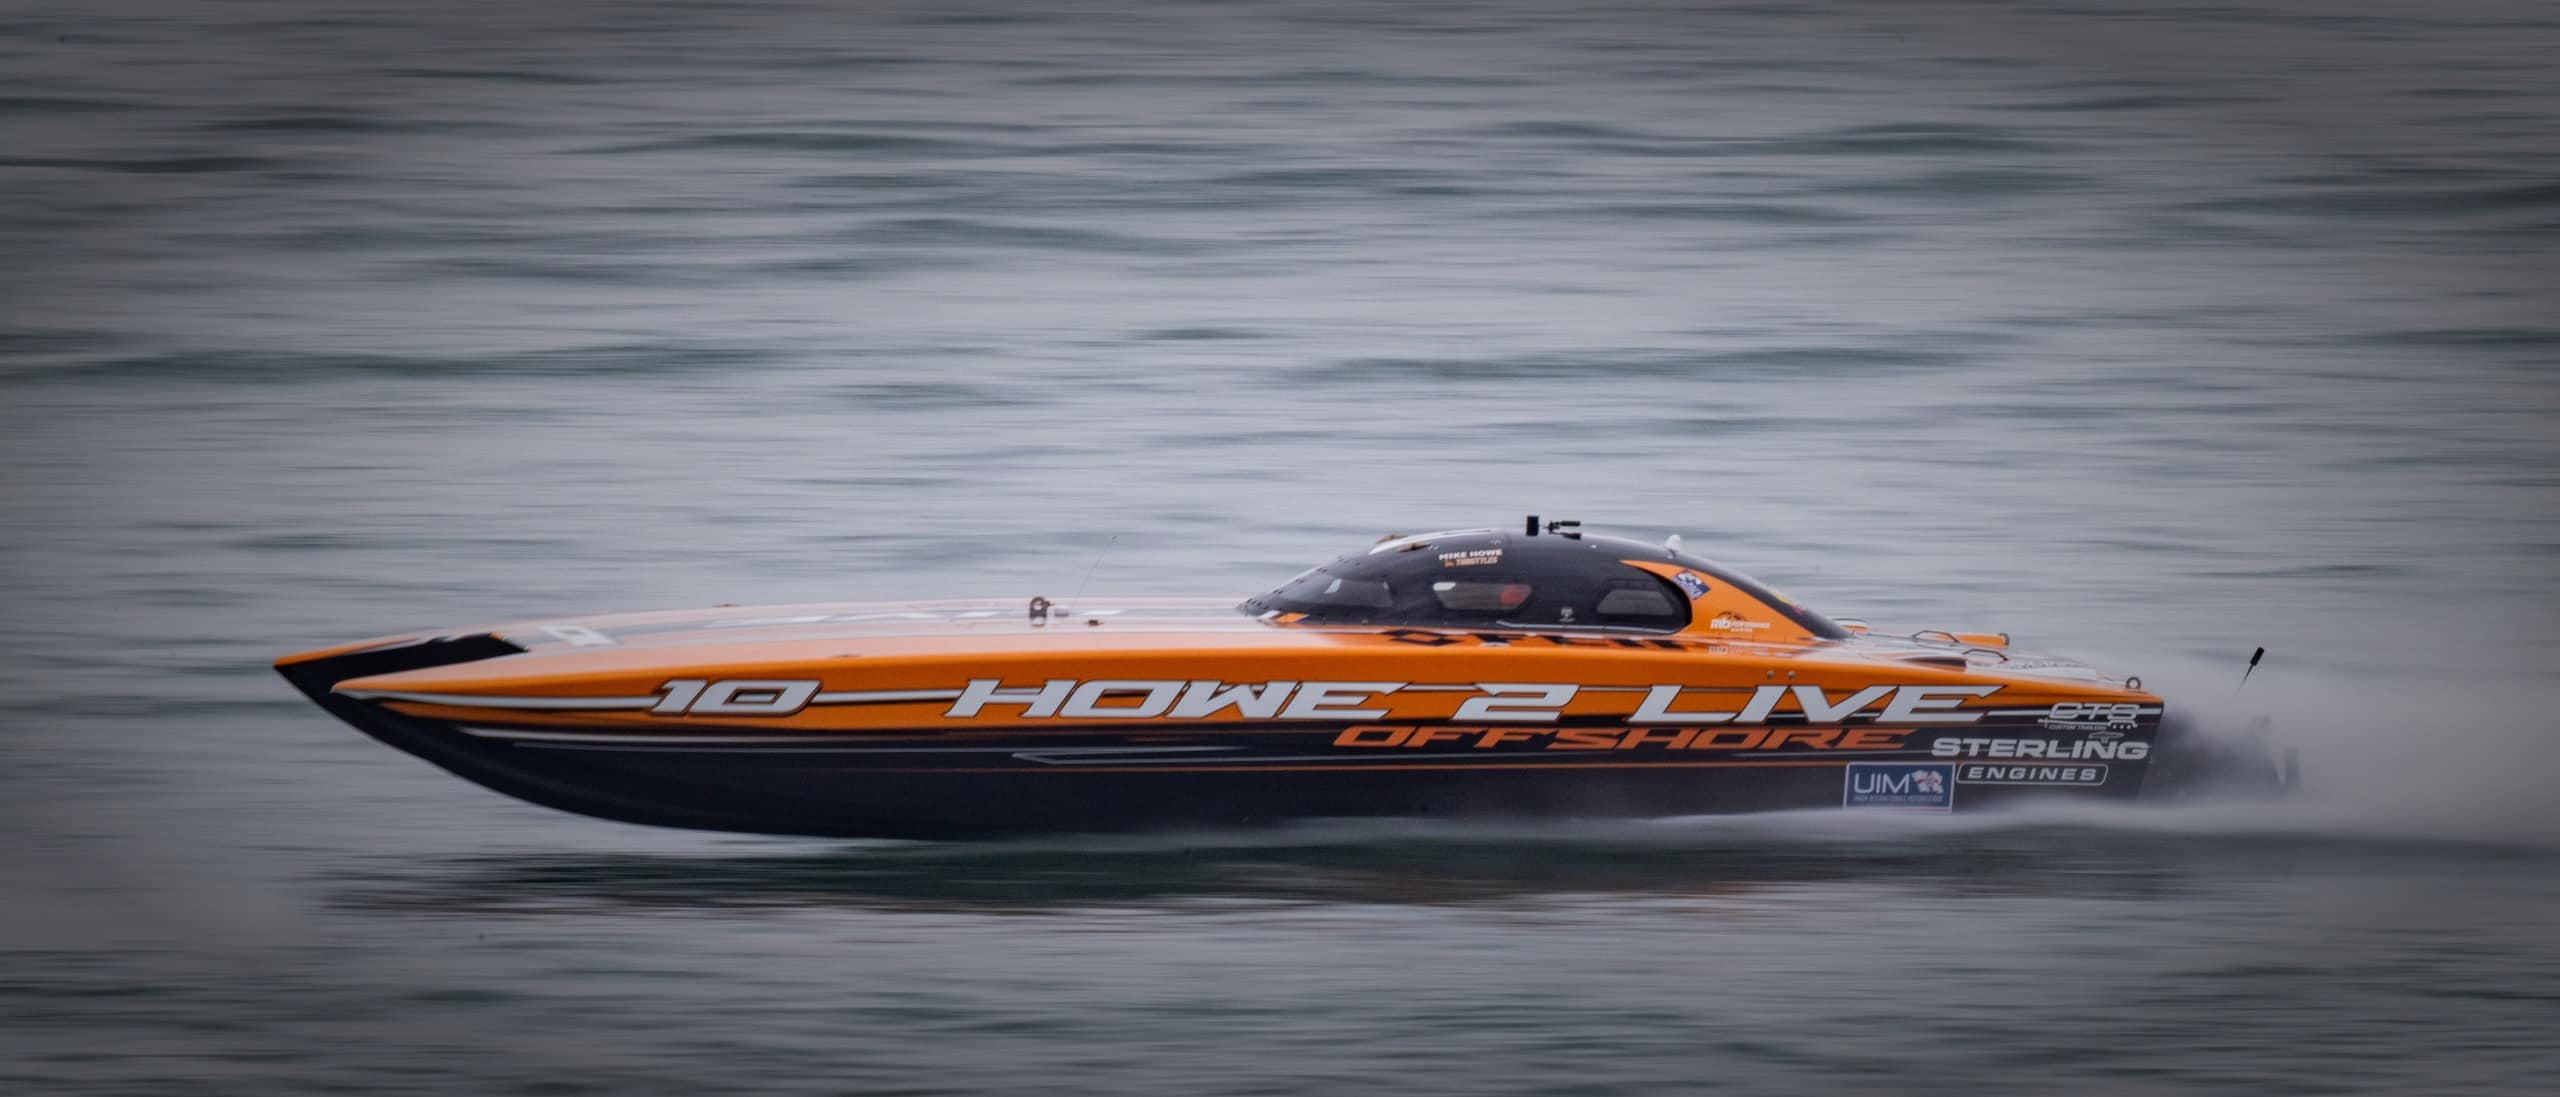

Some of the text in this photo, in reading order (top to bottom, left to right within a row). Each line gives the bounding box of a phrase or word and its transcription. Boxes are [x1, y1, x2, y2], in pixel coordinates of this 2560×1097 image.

[1438, 548, 1503, 560] MIKE HOWE
[648, 679, 823, 717] 10
[942, 679, 2008, 723] HOWE 2 LIVE
[2049, 702, 2140, 720] CTS
[1333, 726, 1918, 751] OFFSHORE
[1931, 737, 2150, 760] STERLING
[1854, 773, 1911, 794] UIM
[1967, 766, 2097, 782] ENGINES
